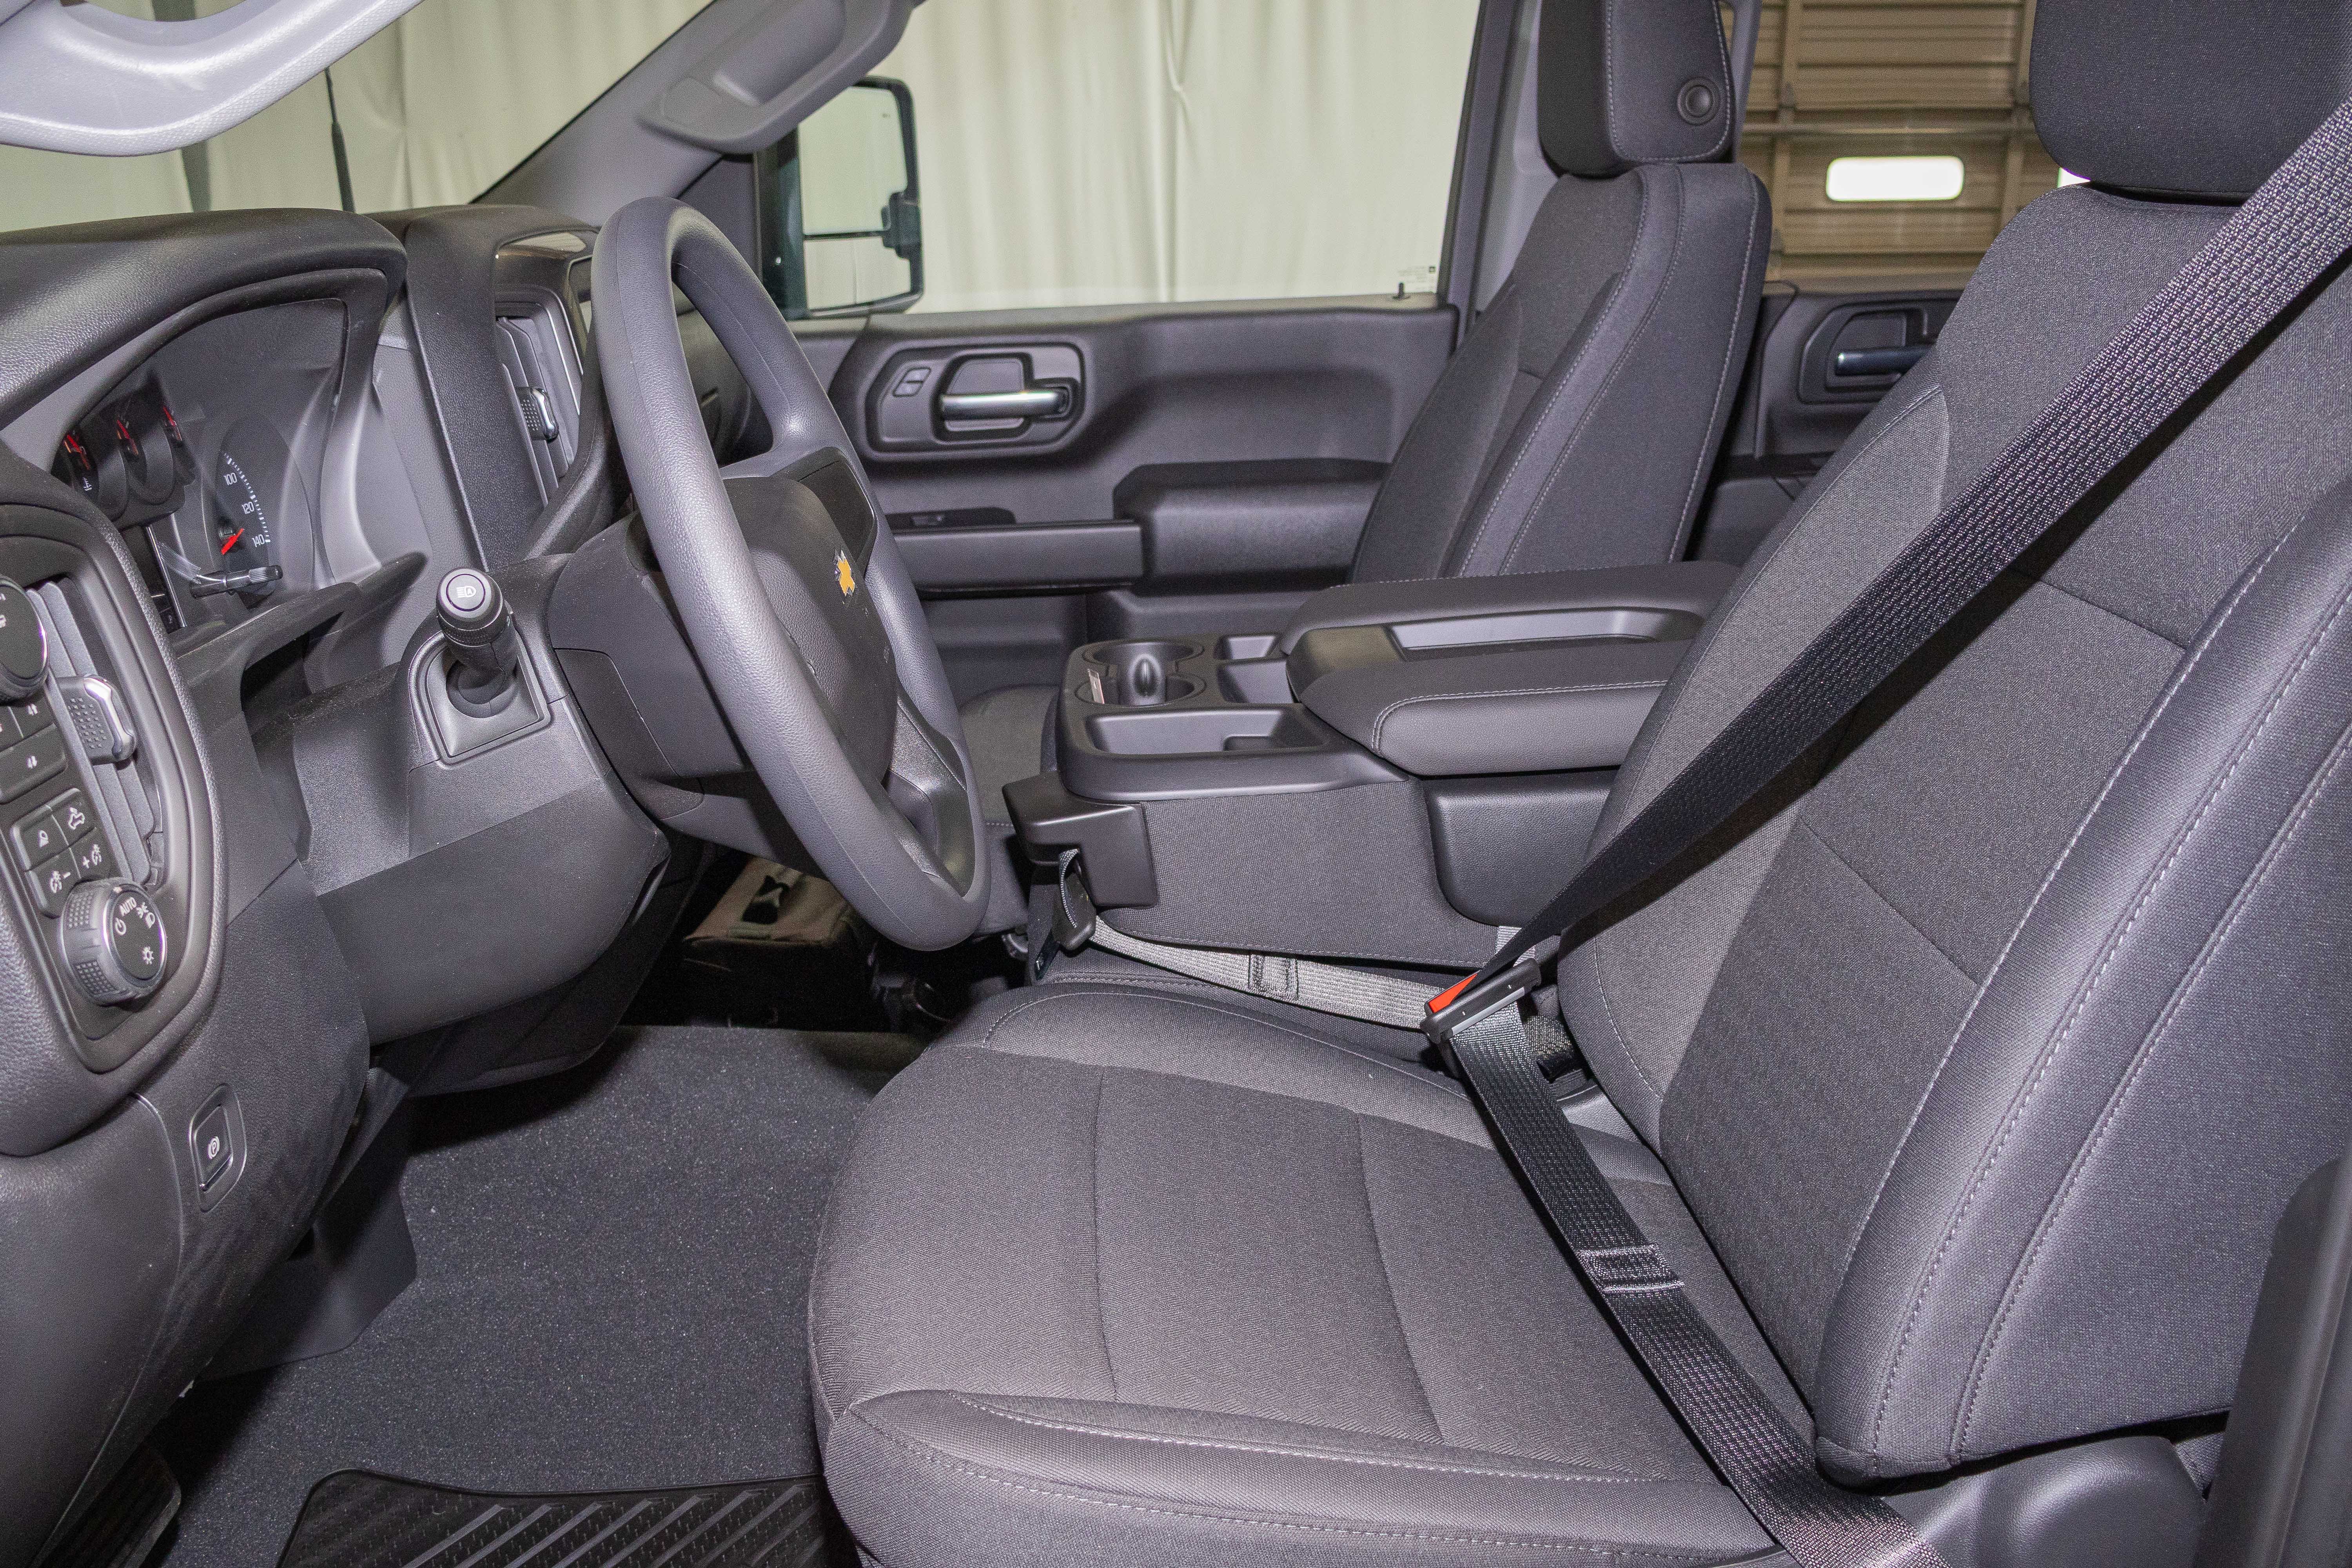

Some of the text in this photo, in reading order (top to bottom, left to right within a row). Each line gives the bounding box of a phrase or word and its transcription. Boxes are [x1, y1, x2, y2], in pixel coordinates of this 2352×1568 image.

[223, 473, 237, 485] 100
[241, 501, 254, 514] 120
[252, 534, 265, 547] 140
[119, 897, 137, 917] AUTO
